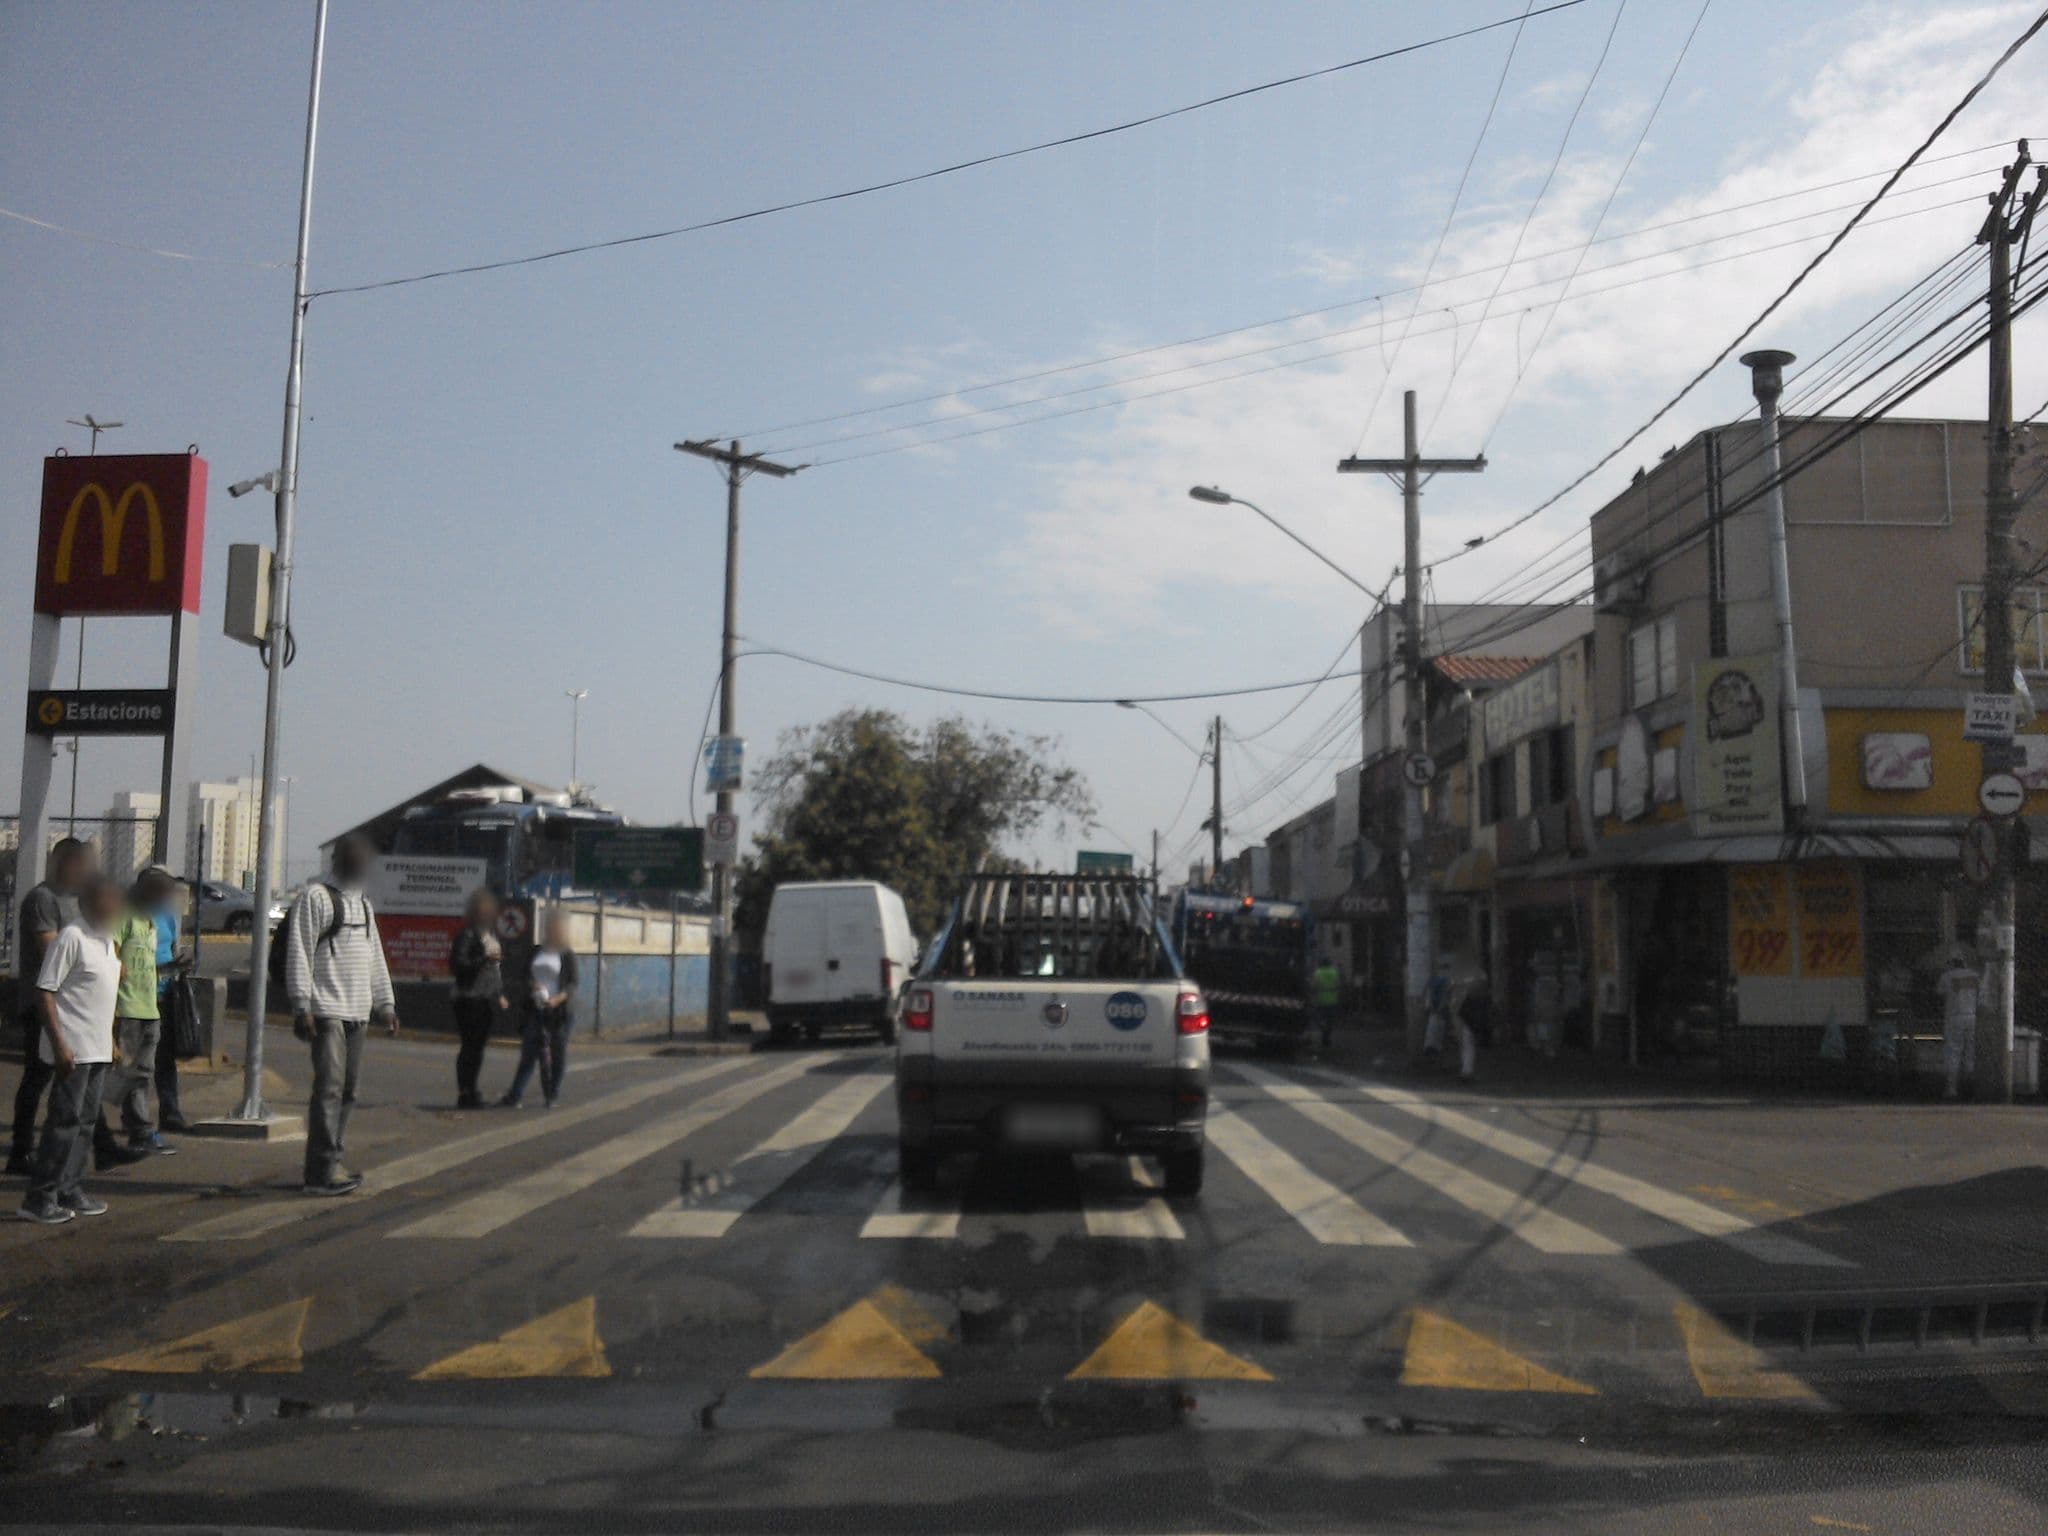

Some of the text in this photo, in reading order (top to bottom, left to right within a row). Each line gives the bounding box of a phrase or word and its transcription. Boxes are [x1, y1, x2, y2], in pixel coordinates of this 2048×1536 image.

[66, 702, 162, 721] Estacione
[1972, 710, 2010, 721] TAXI
[385, 863, 480, 874] ESTACIONAMENTO
[406, 874, 456, 884] TERMINAL
[968, 991, 1025, 1000] SANASA
[1107, 1002, 1146, 1019] 086
